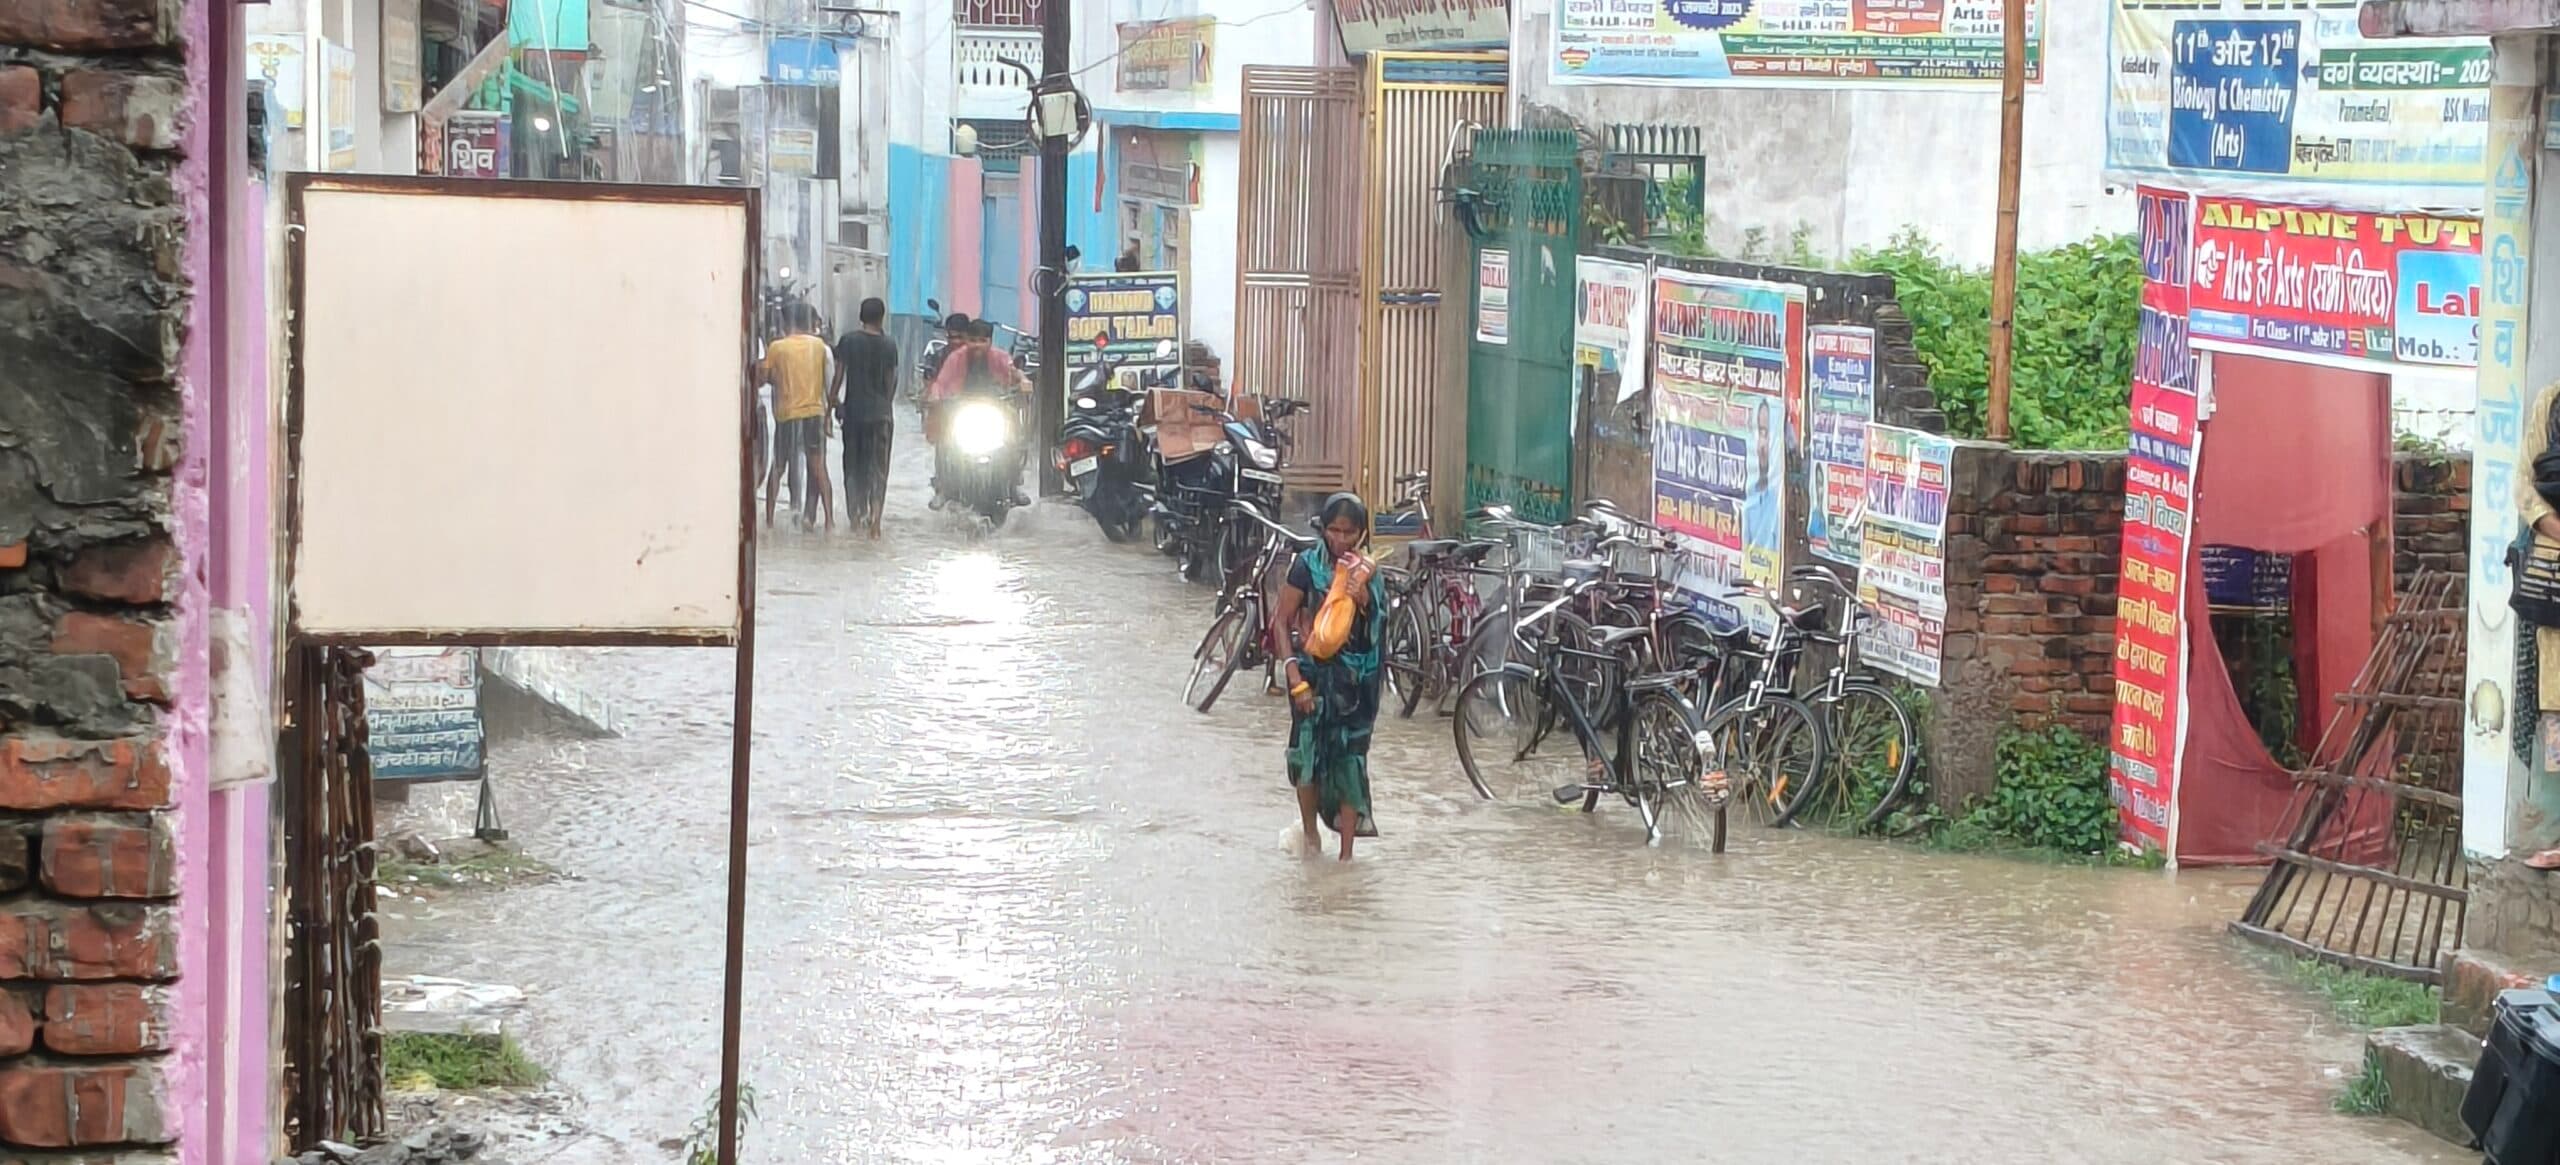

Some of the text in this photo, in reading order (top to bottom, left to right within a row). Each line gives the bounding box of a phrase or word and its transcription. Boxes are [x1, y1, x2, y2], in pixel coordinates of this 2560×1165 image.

[1953, 7, 1984, 20] Arts
[2213, 29, 2256, 67] और
[2173, 76, 2217, 121] Biology
[2229, 78, 2292, 124] Chemistry
[450, 138, 497, 172] शिव
[2211, 123, 2245, 168] (Arts)
[2201, 203, 2359, 241] ALPINE
[2222, 240, 2253, 303] Arts
[2274, 245, 2306, 309] Arts
[1828, 356, 1865, 379] English
